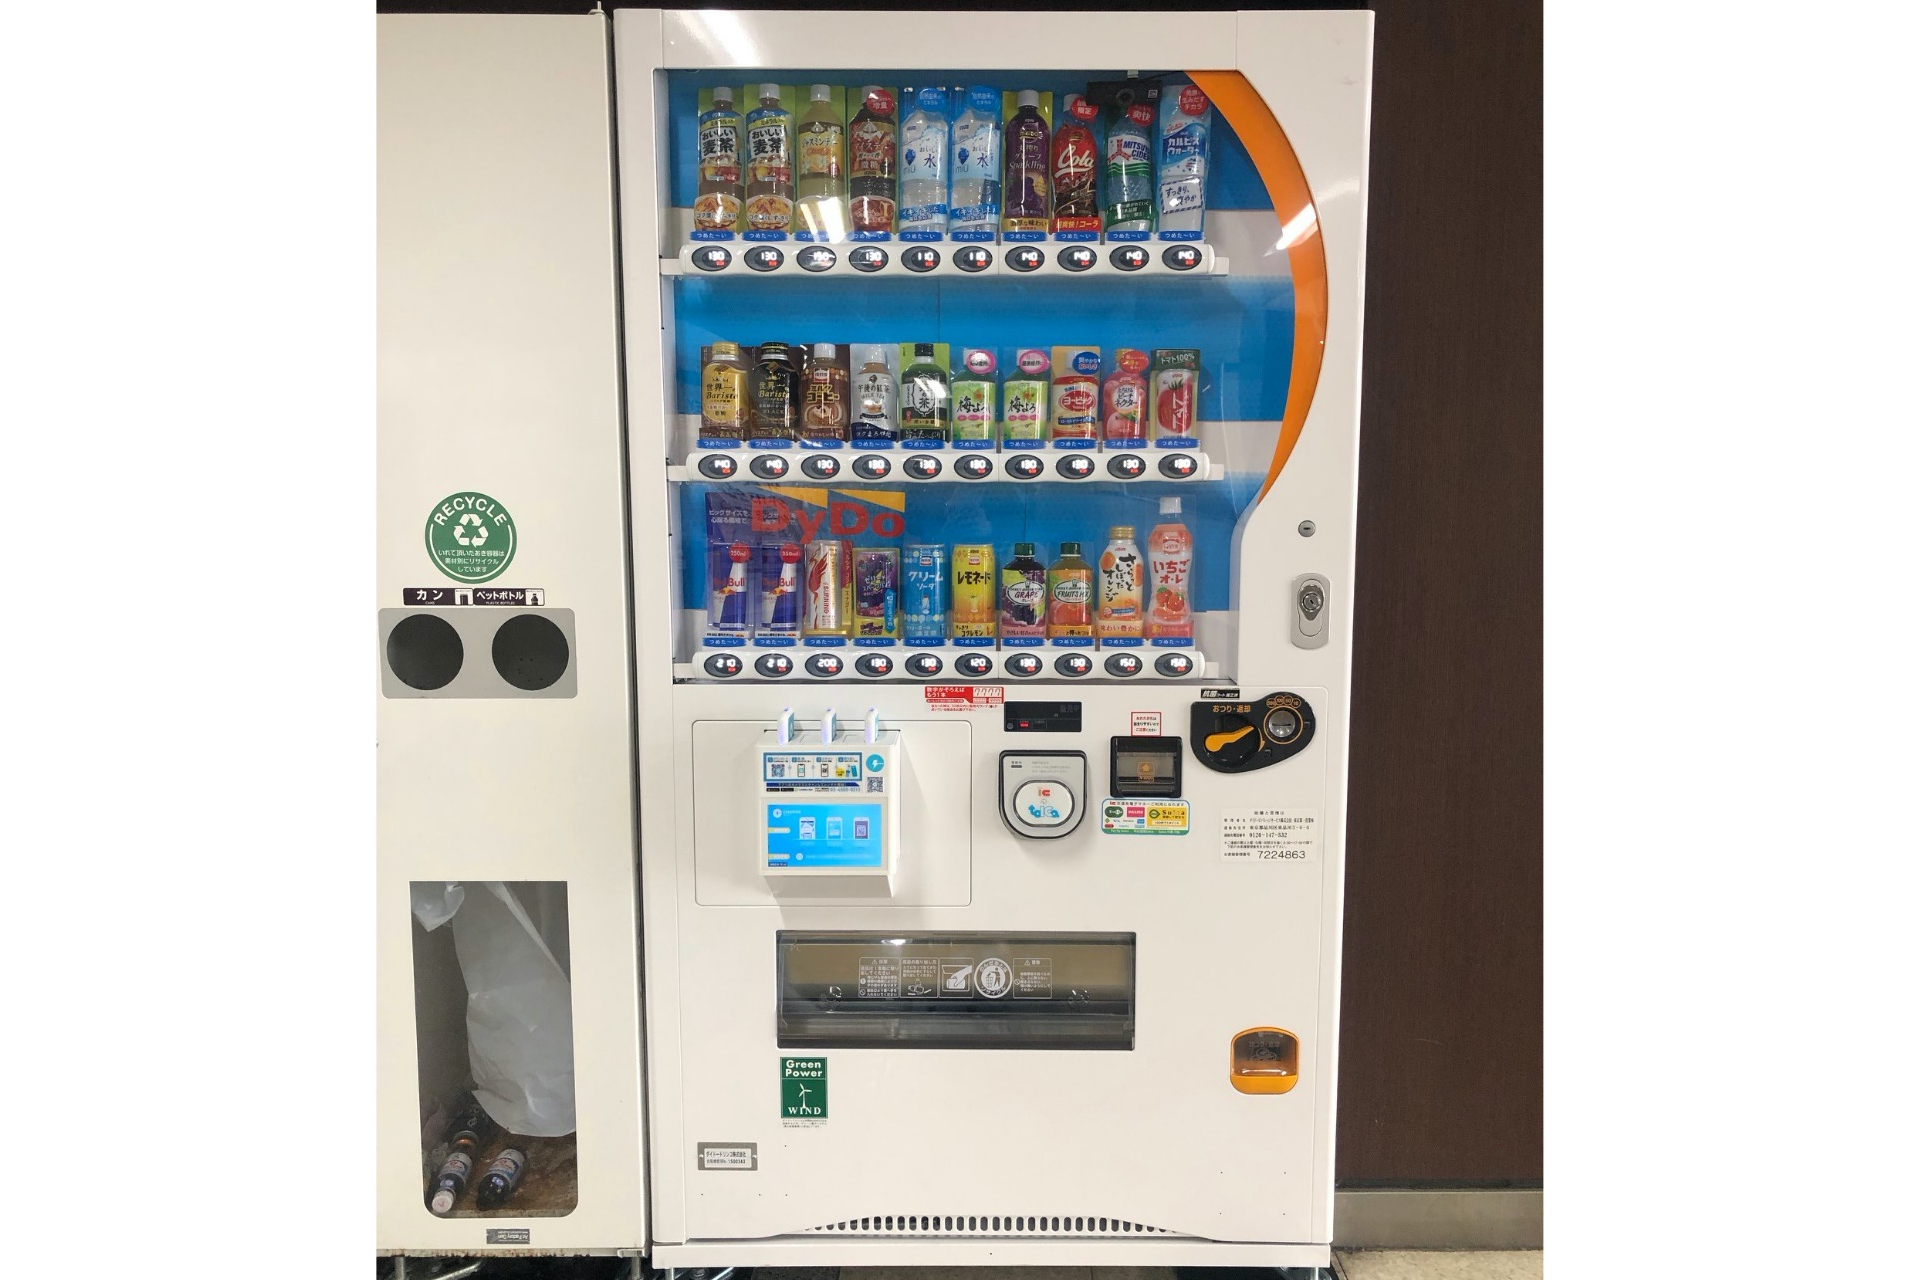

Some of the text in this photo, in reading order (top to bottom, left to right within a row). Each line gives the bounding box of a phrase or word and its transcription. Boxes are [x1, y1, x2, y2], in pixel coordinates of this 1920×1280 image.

[702, 129, 733, 140] おいしい
[753, 137, 782, 156] 麦茶
[1167, 137, 1200, 146] カルピス
[702, 138, 734, 156] 麦茶
[924, 153, 937, 168] 水
[976, 152, 989, 168] 水
[1058, 145, 1095, 169] Cola
[708, 251, 726, 261] 130
[762, 252, 777, 260] 130
[865, 251, 882, 261] 130
[918, 252, 933, 261] 110
[970, 251, 986, 261] 110
[1022, 252, 1037, 261] 140
[1074, 251, 1090, 261] 140
[1127, 251, 1142, 260] 140
[1179, 251, 1194, 259] 140
[1161, 353, 1195, 365] トマト100%
[857, 384, 890, 394] 午後の紅茶
[807, 391, 840, 403] コーヒー
[433, 496, 507, 526] RECYCLE
[751, 498, 905, 544] DyDo
[438, 549, 505, 557] いれて頂いたあき容器は
[445, 557, 499, 565] 素材別にリサイクル
[457, 565, 487, 573] しています
[1153, 559, 1190, 574] いちご
[908, 571, 944, 582] クリーム
[1119, 553, 1137, 591] さらっと
[728, 577, 745, 587] Bull
[779, 577, 796, 587] Bull
[957, 571, 991, 585] レモネード
[1103, 569, 1119, 602] オレンジ
[476, 590, 524, 600] ペットボトル
[1014, 591, 1039, 599] GRAPE
[961, 629, 984, 637] コクレモン
[717, 659, 735, 667] 210
[767, 658, 786, 667] 210
[818, 658, 837, 667] 200
[872, 658, 886, 667] 130
[922, 658, 936, 667] 130
[971, 658, 986, 666] 120
[1021, 658, 1036, 667] 130
[1071, 658, 1085, 667] 130
[1120, 658, 1135, 667] 150
[1171, 658, 1186, 667] 150
[1212, 704, 1251, 713] おつり・返却
[1257, 850, 1306, 859] 7224863
[786, 1059, 822, 1069] Green
[785, 1068, 823, 1078] Power
[788, 1106, 822, 1115] WIND
